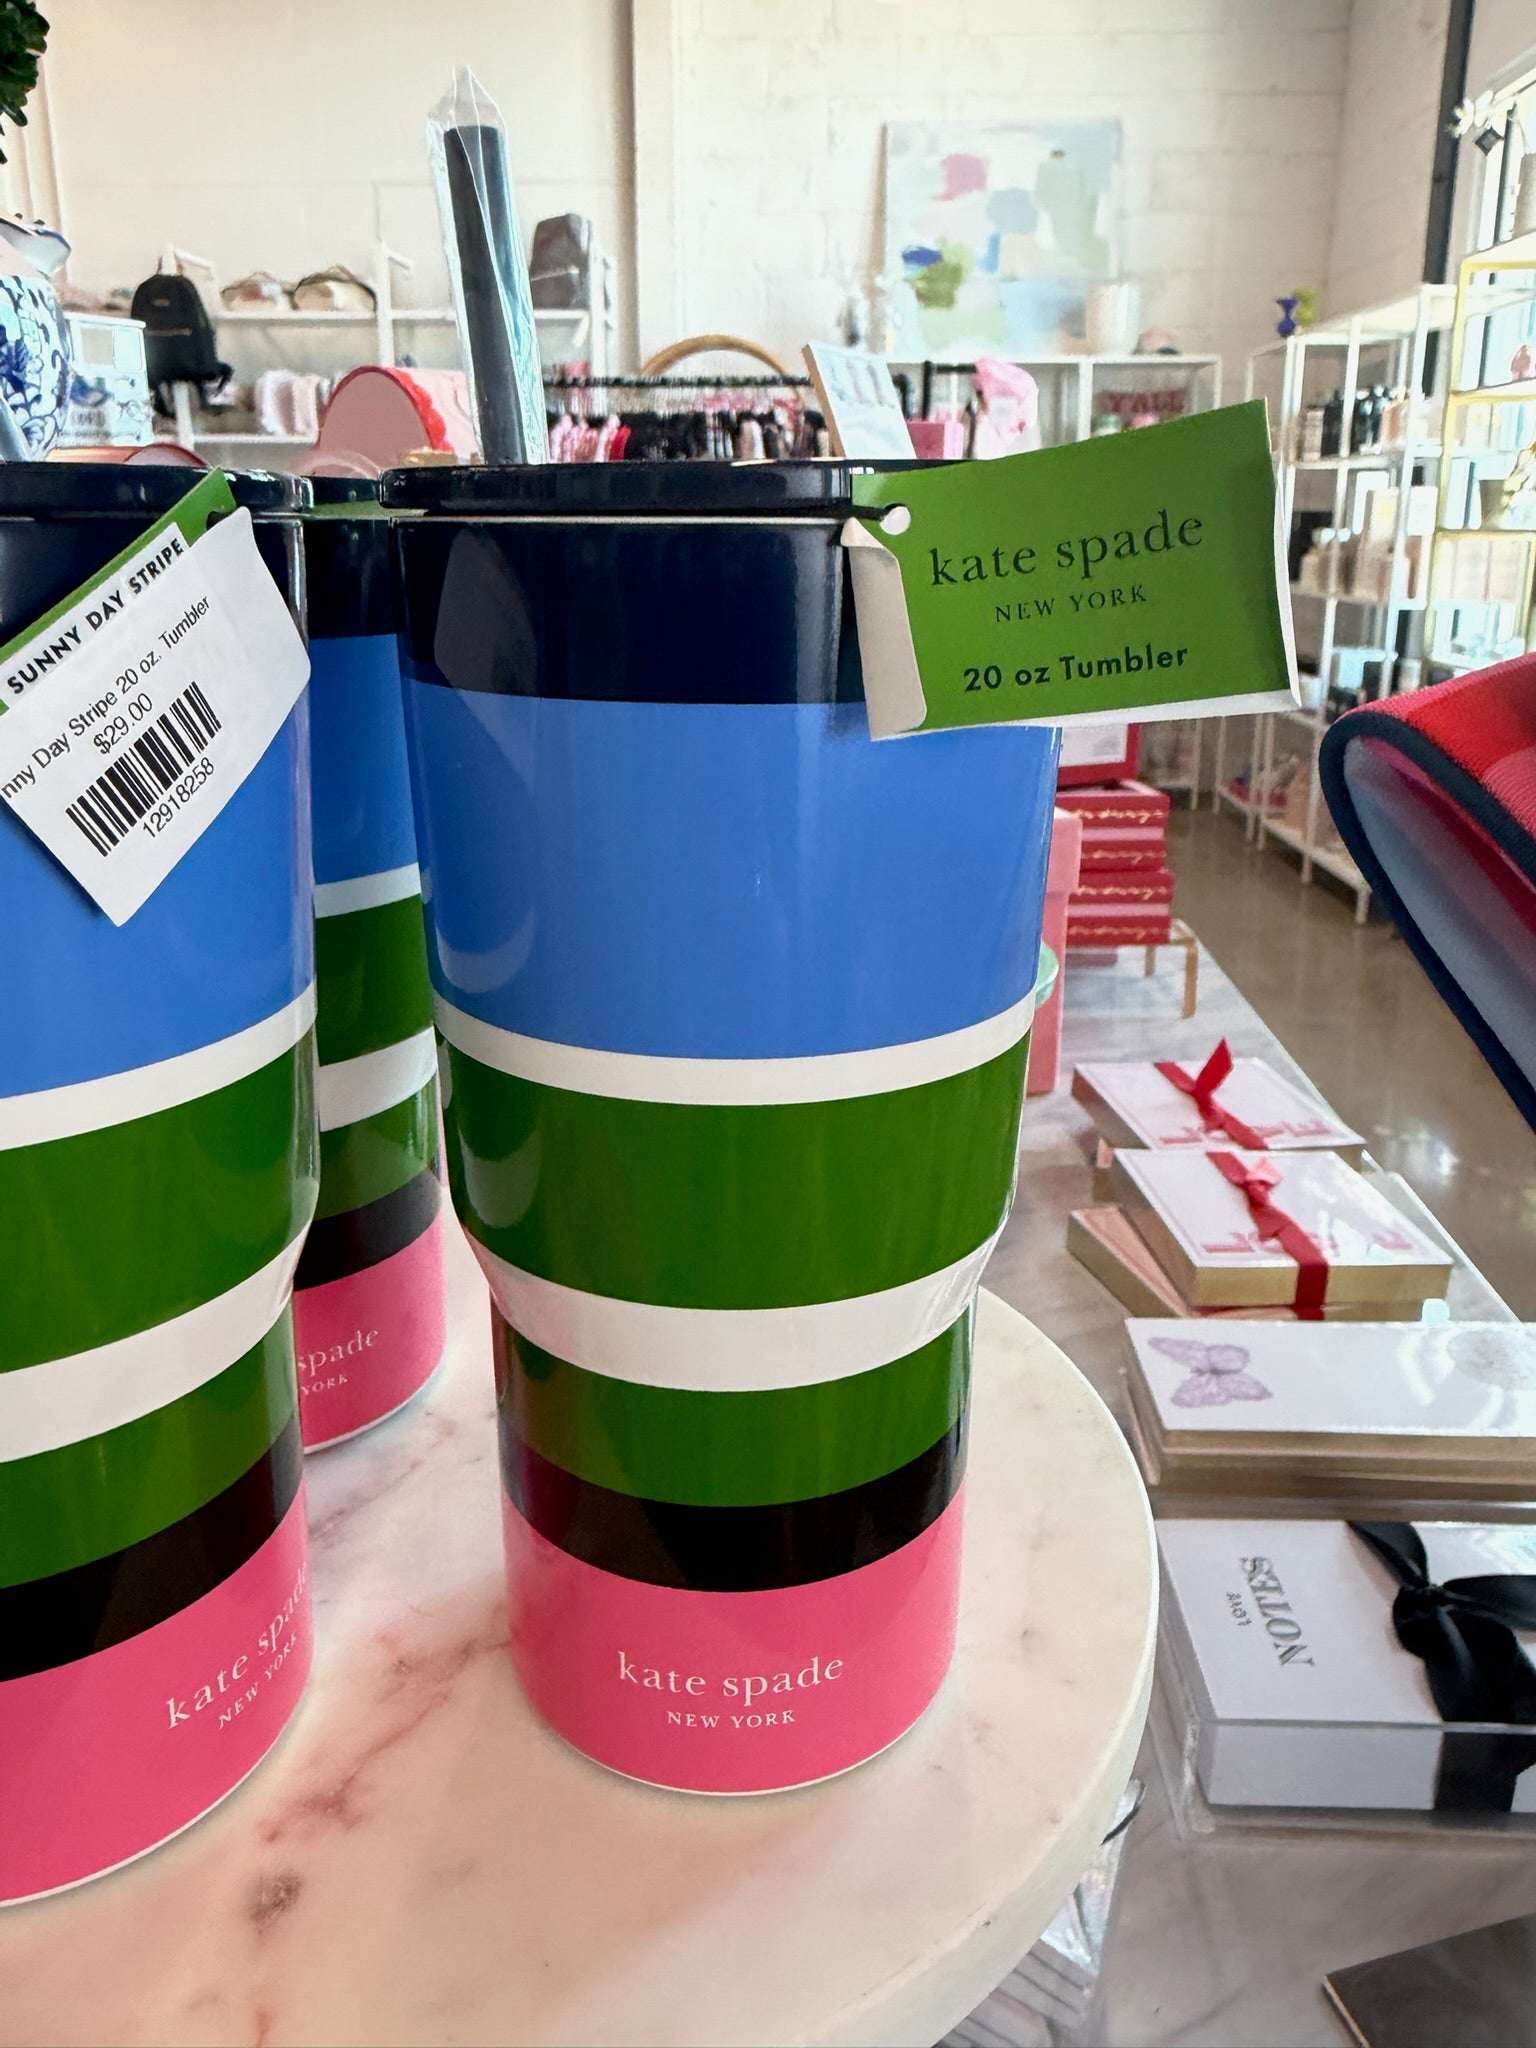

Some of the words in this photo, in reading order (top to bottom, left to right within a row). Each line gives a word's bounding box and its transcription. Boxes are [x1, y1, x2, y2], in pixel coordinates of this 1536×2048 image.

[930, 547, 1037, 586] kate
[1056, 509, 1204, 579] spade
[7, 625, 81, 694] SUNNY
[85, 590, 125, 631] DAY
[128, 538, 184, 595] STRIPE
[995, 597, 1056, 623] NEW
[1069, 584, 1148, 613] YORK
[1, 765, 37, 799] nny
[32, 732, 71, 769] Day
[69, 692, 118, 737] Stripe
[116, 668, 139, 694] 20
[139, 650, 162, 674] oz.
[158, 596, 211, 650] Tumbler
[963, 664, 1002, 693] 20
[1015, 666, 1051, 686] oz
[1059, 643, 1188, 681] Tumbler
[93, 693, 153, 755] $29.00
[142, 757, 215, 838] 12918258
[1239, 1556, 1316, 1667] NOTES
[166, 1655, 248, 1729] kate
[219, 1682, 259, 1730] NEW
[617, 1650, 707, 1696] kate
[723, 1656, 844, 1707] spade
[666, 1710, 720, 1729] NEW
[730, 1709, 796, 1729] YORK
